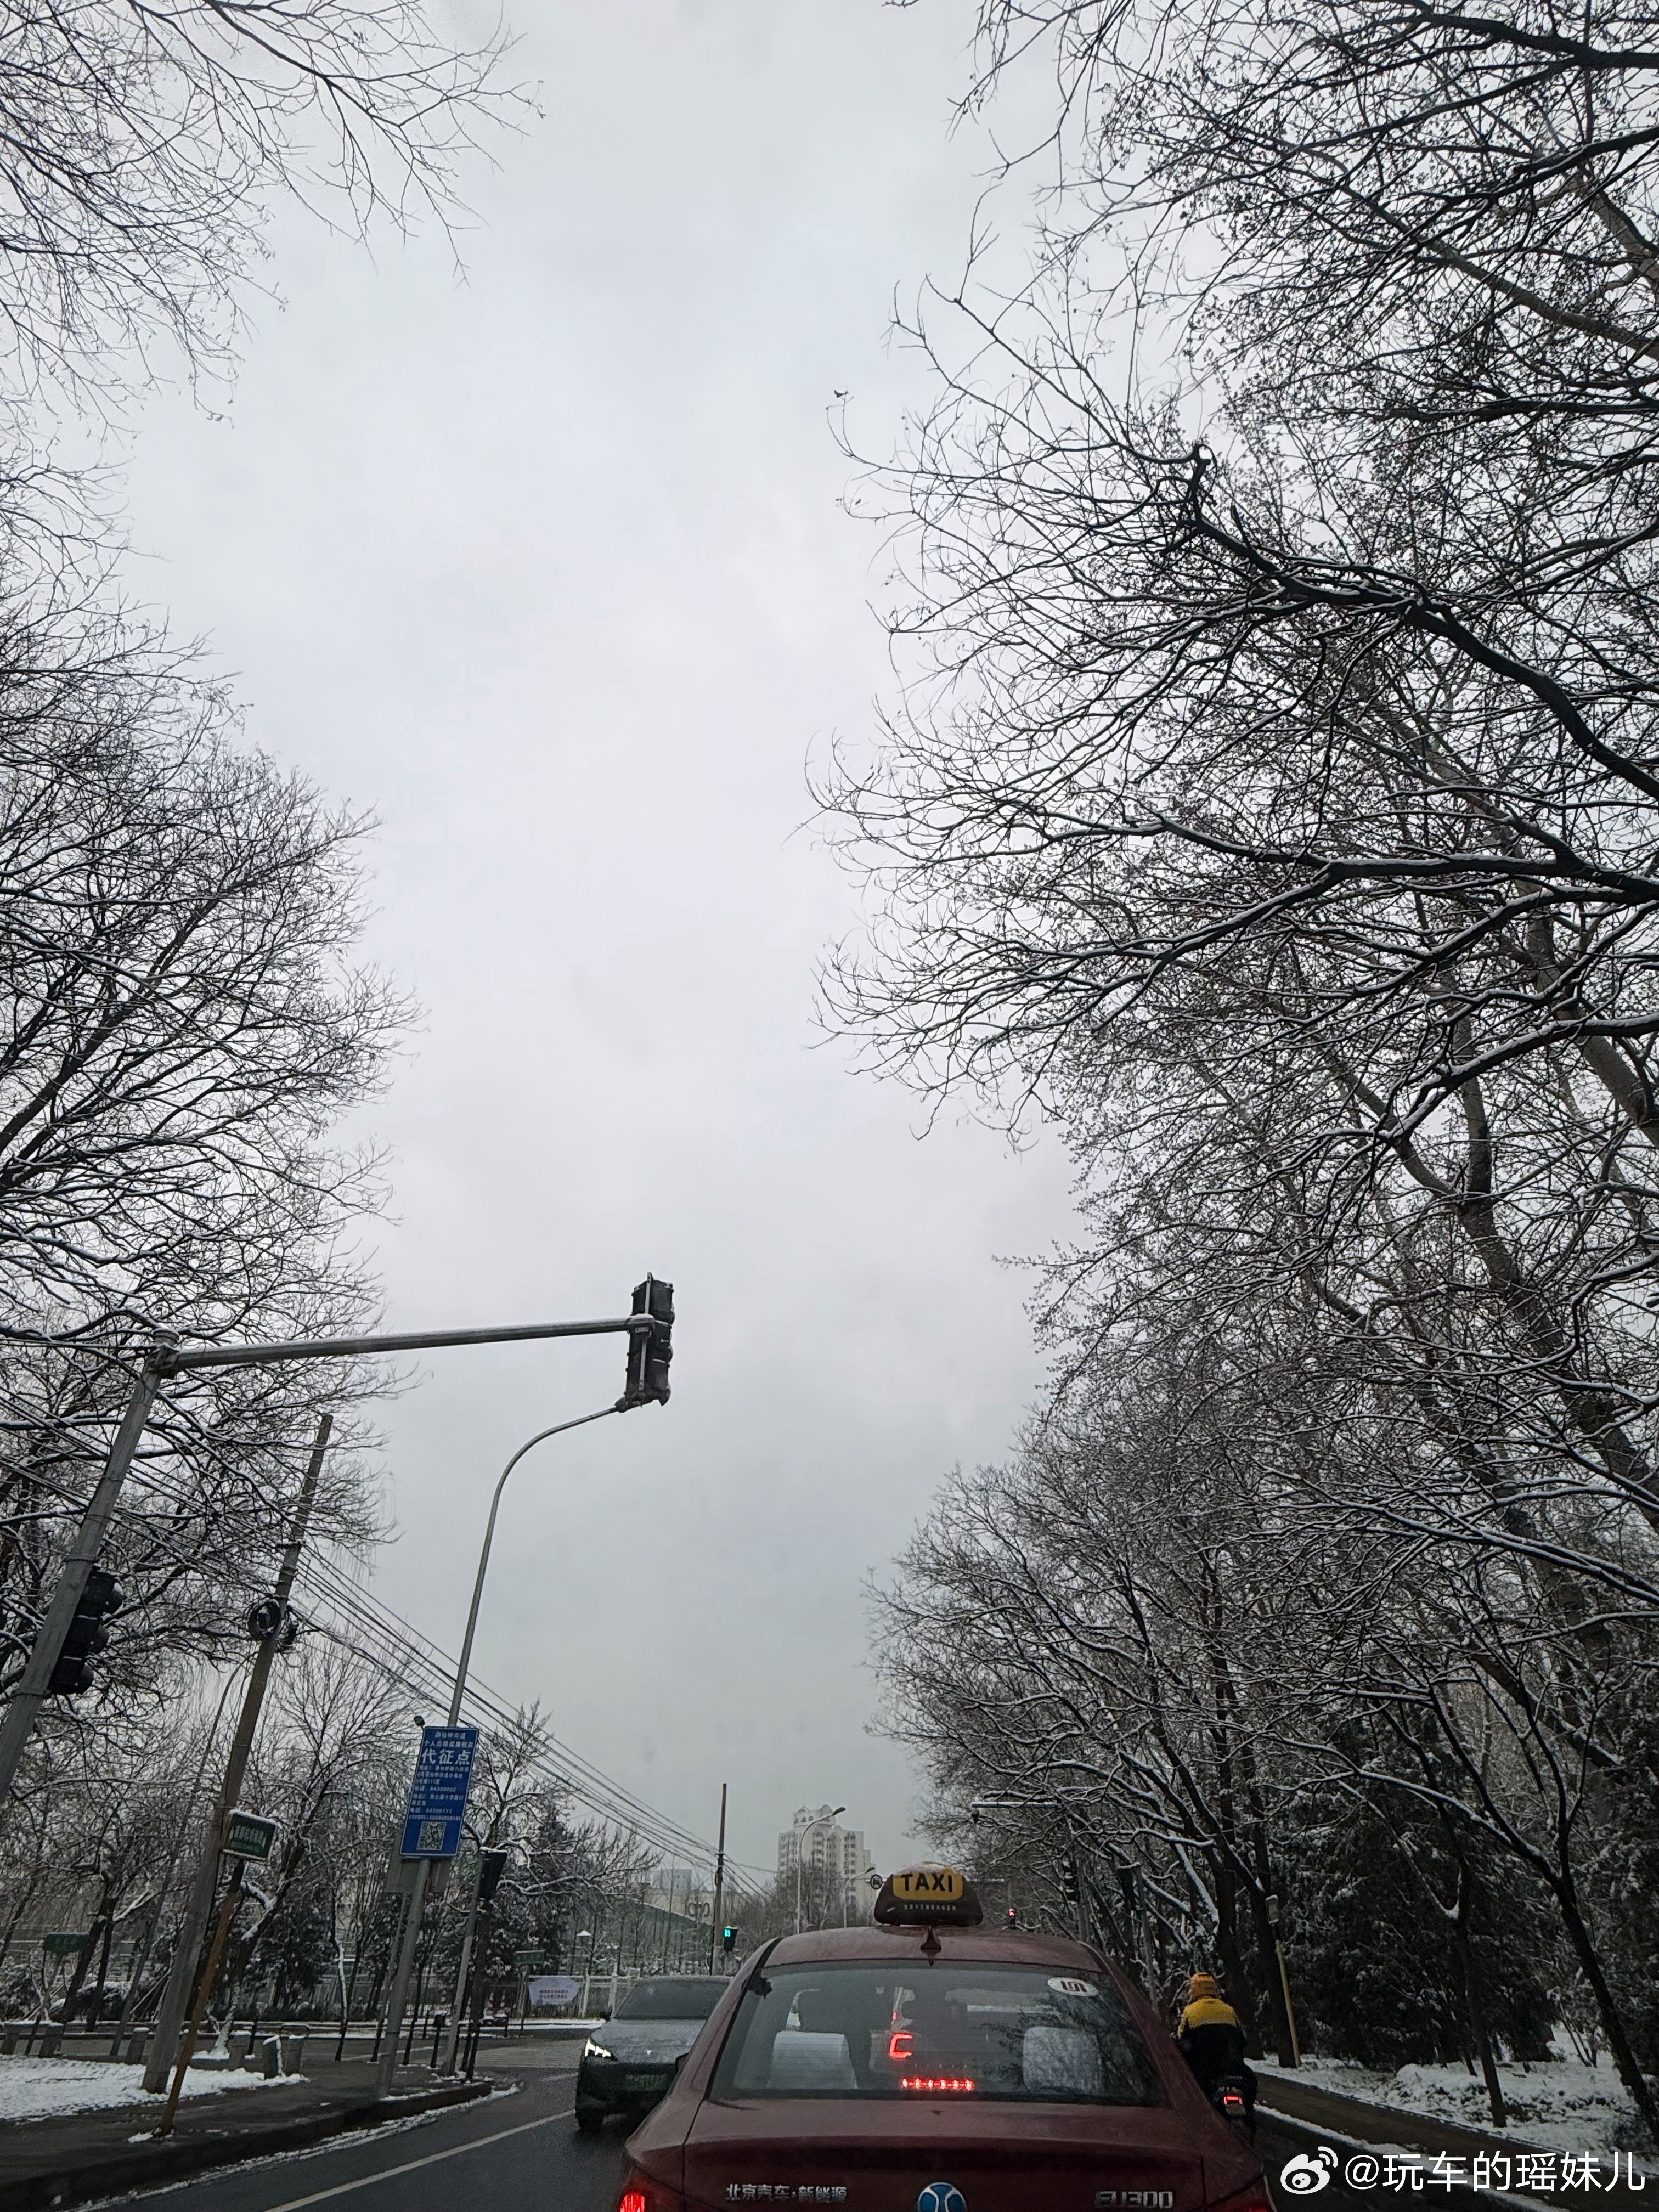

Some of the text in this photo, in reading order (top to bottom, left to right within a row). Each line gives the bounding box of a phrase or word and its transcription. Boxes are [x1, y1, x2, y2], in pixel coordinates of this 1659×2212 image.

[421, 1748, 471, 1765] 代征点
[901, 1872, 953, 1892] TAXI
[1095, 2191, 1173, 2208] EU300
